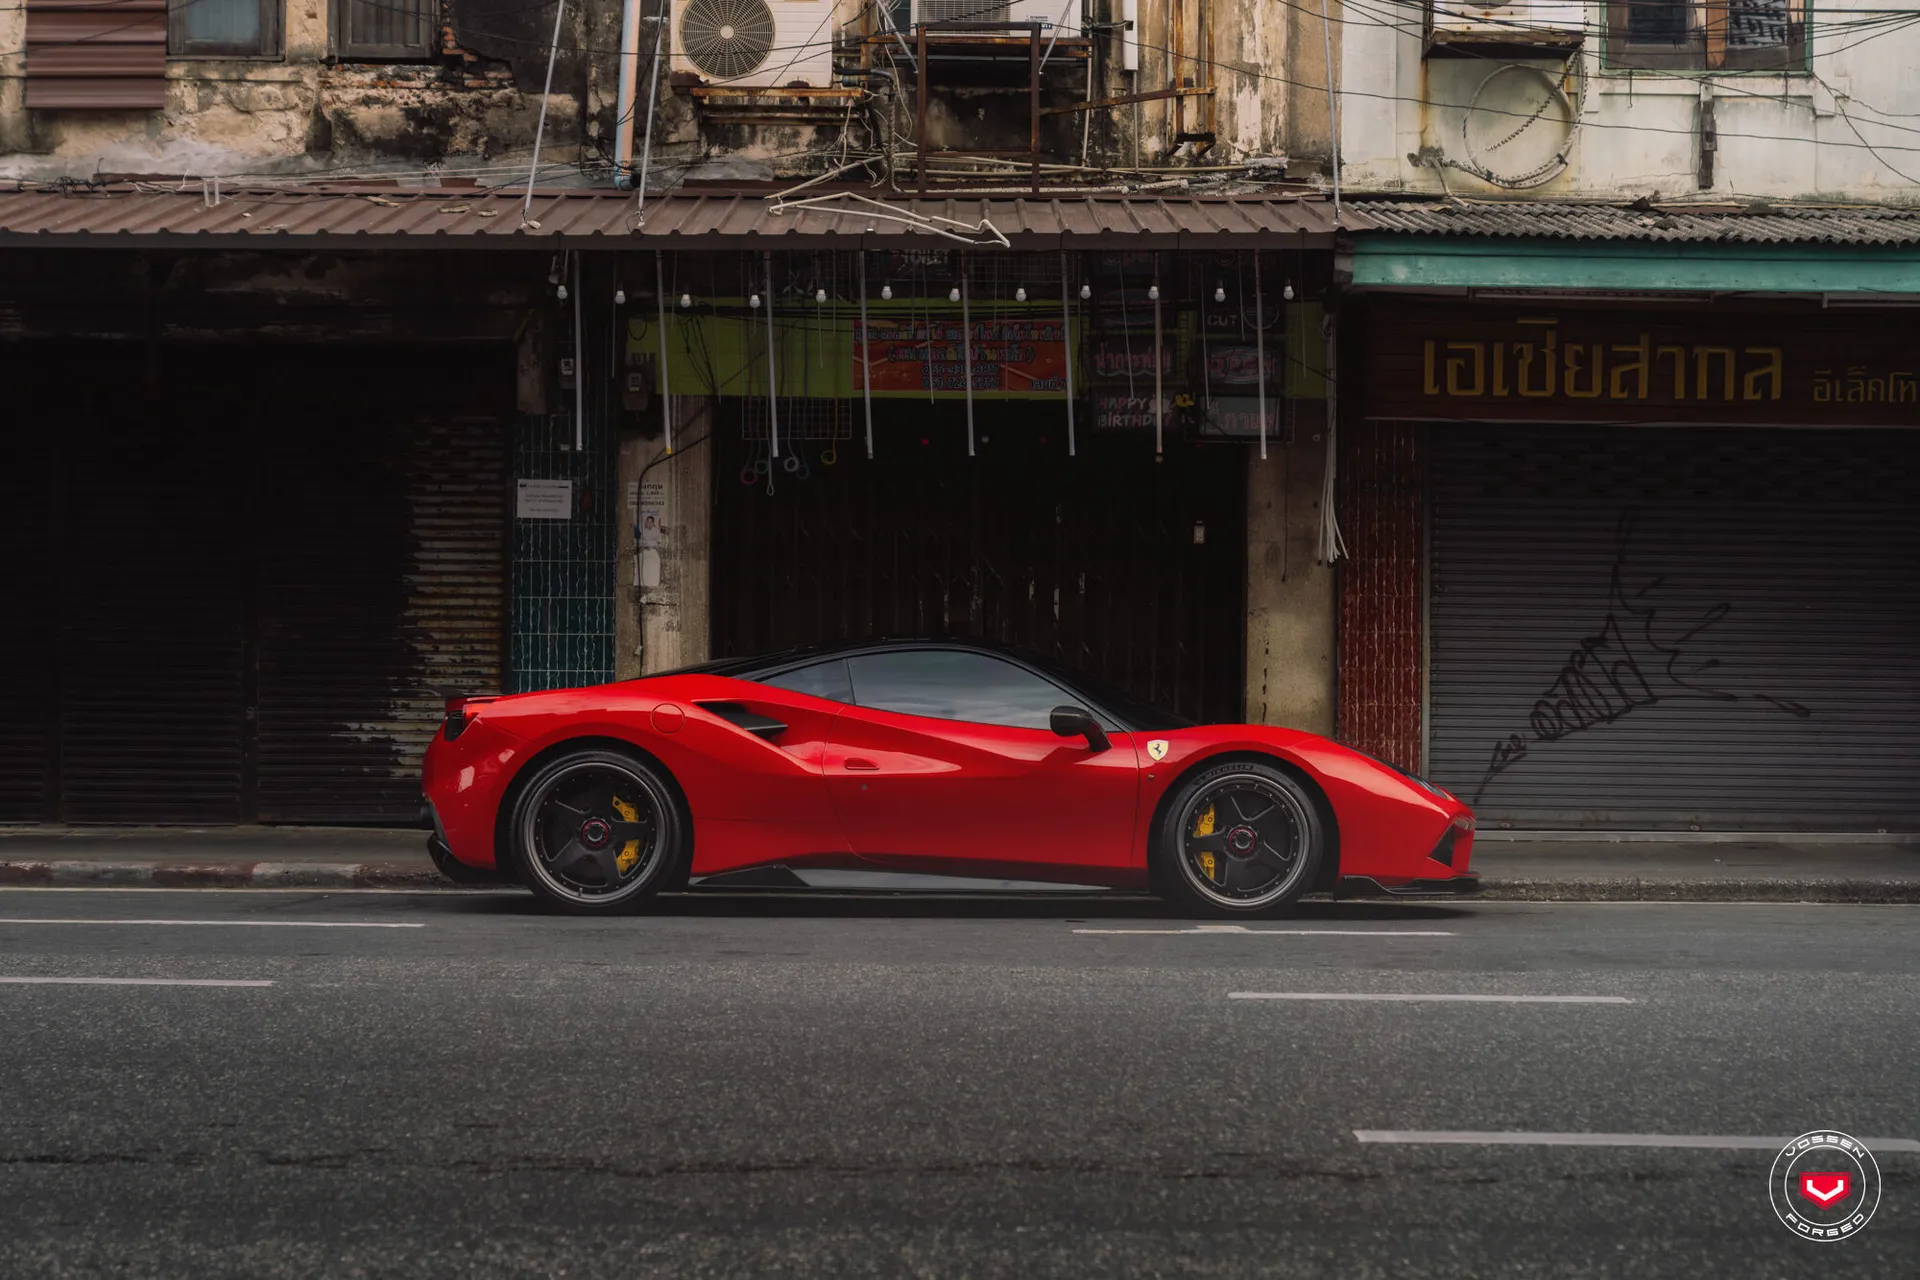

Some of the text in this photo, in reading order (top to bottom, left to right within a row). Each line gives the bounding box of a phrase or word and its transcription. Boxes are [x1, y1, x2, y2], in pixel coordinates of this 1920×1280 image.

[1423, 317, 1784, 400] เอเชียสากล
[1099, 396, 1147, 410] HAPPY
[1097, 412, 1172, 428] BIRTHDY
